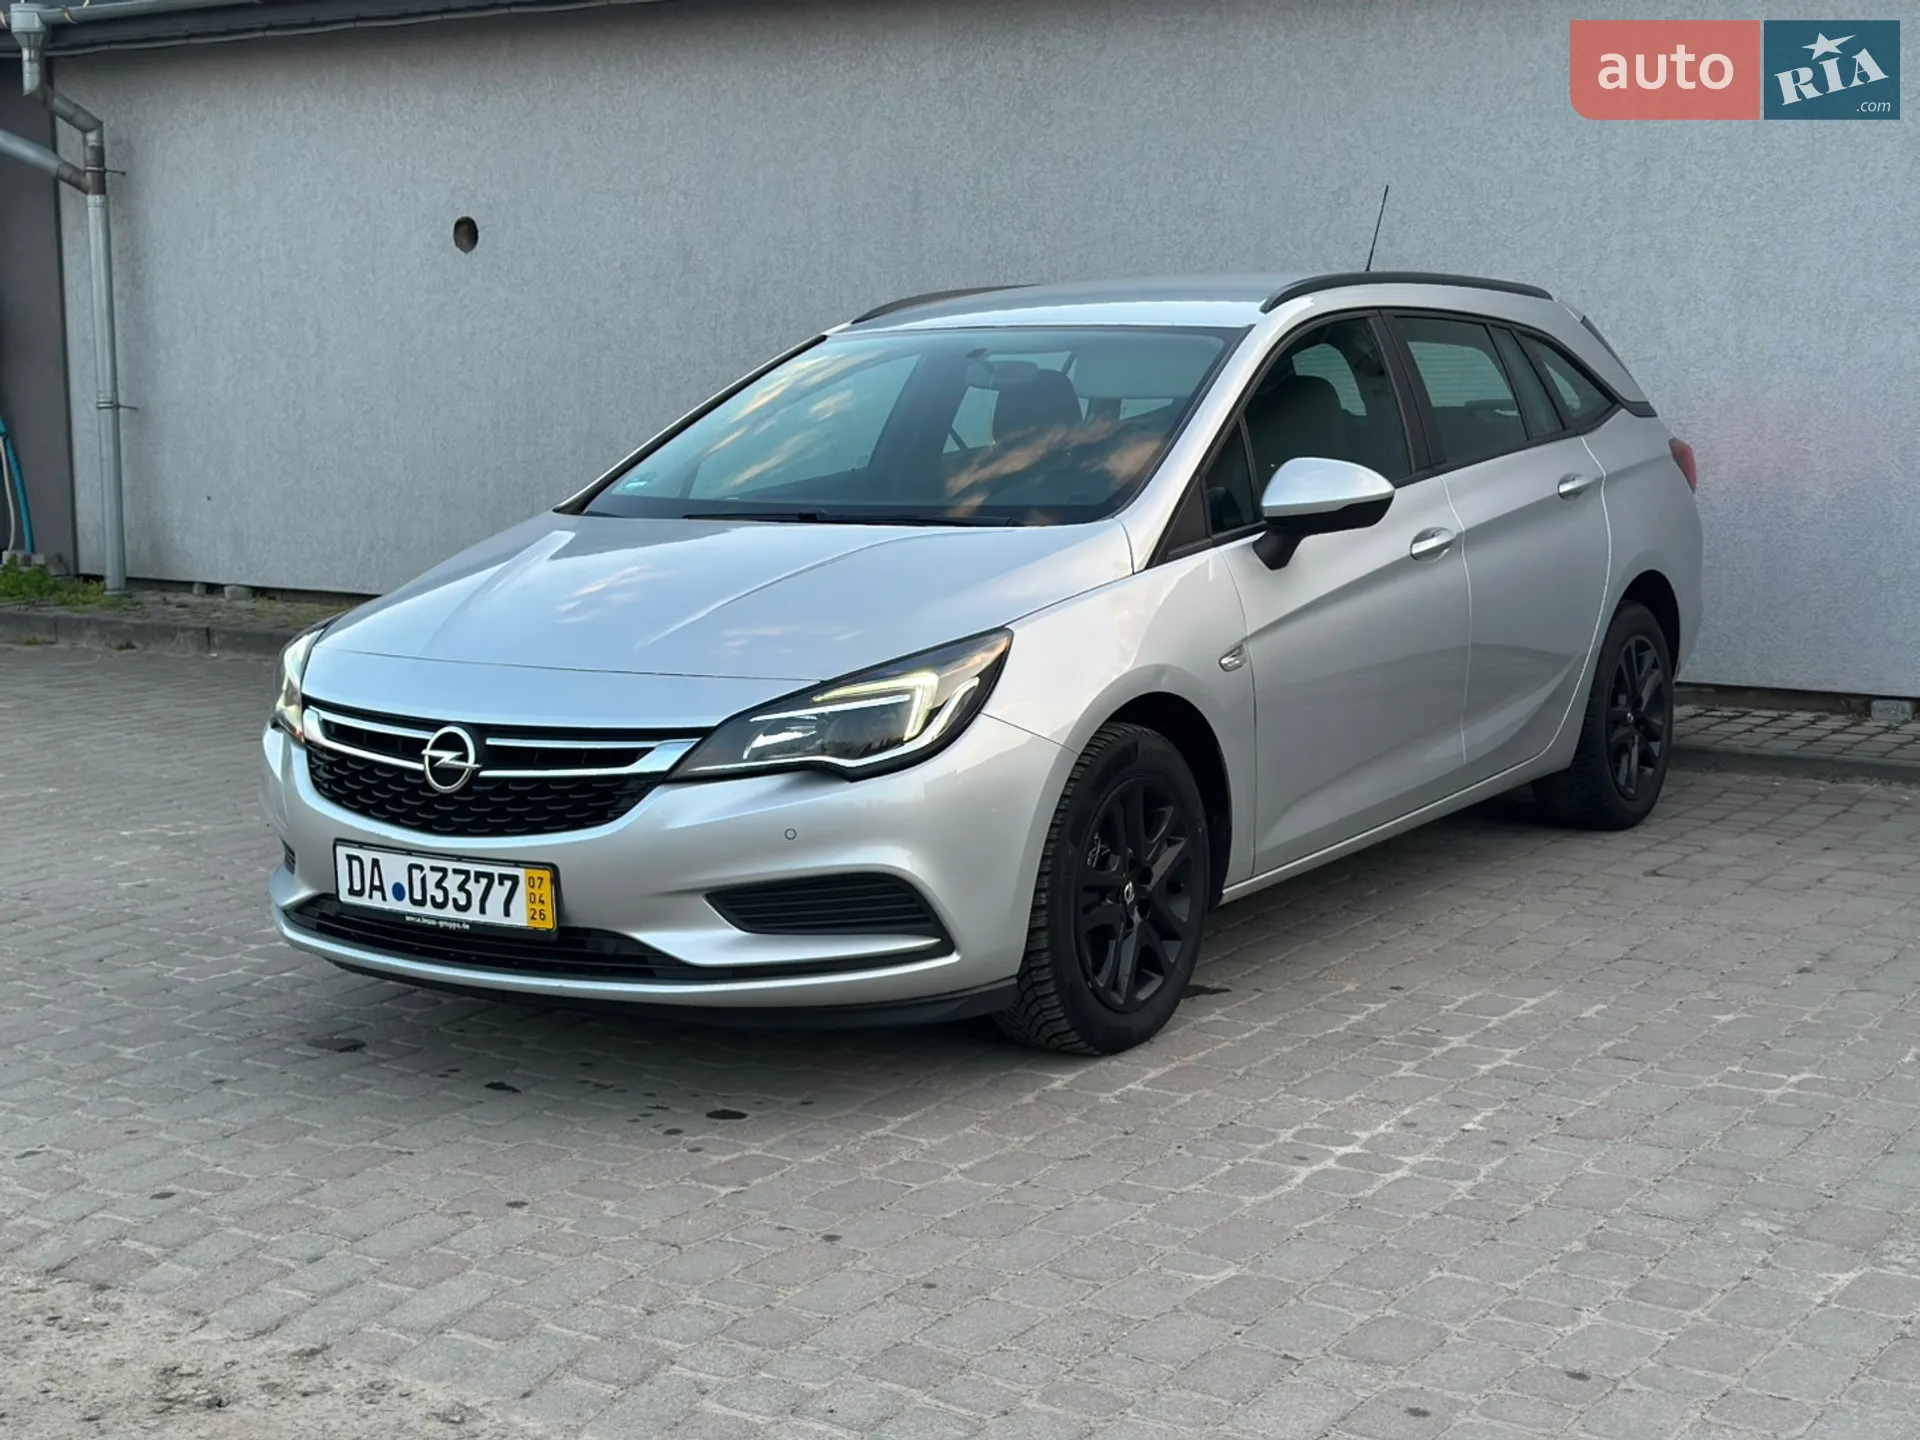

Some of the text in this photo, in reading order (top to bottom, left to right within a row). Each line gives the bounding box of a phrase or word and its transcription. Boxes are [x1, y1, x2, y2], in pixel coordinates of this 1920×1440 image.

[346, 854, 519, 917] DA 03377
[528, 875, 544, 889] 07
[529, 892, 545, 905] 04
[530, 907, 547, 921] 26
